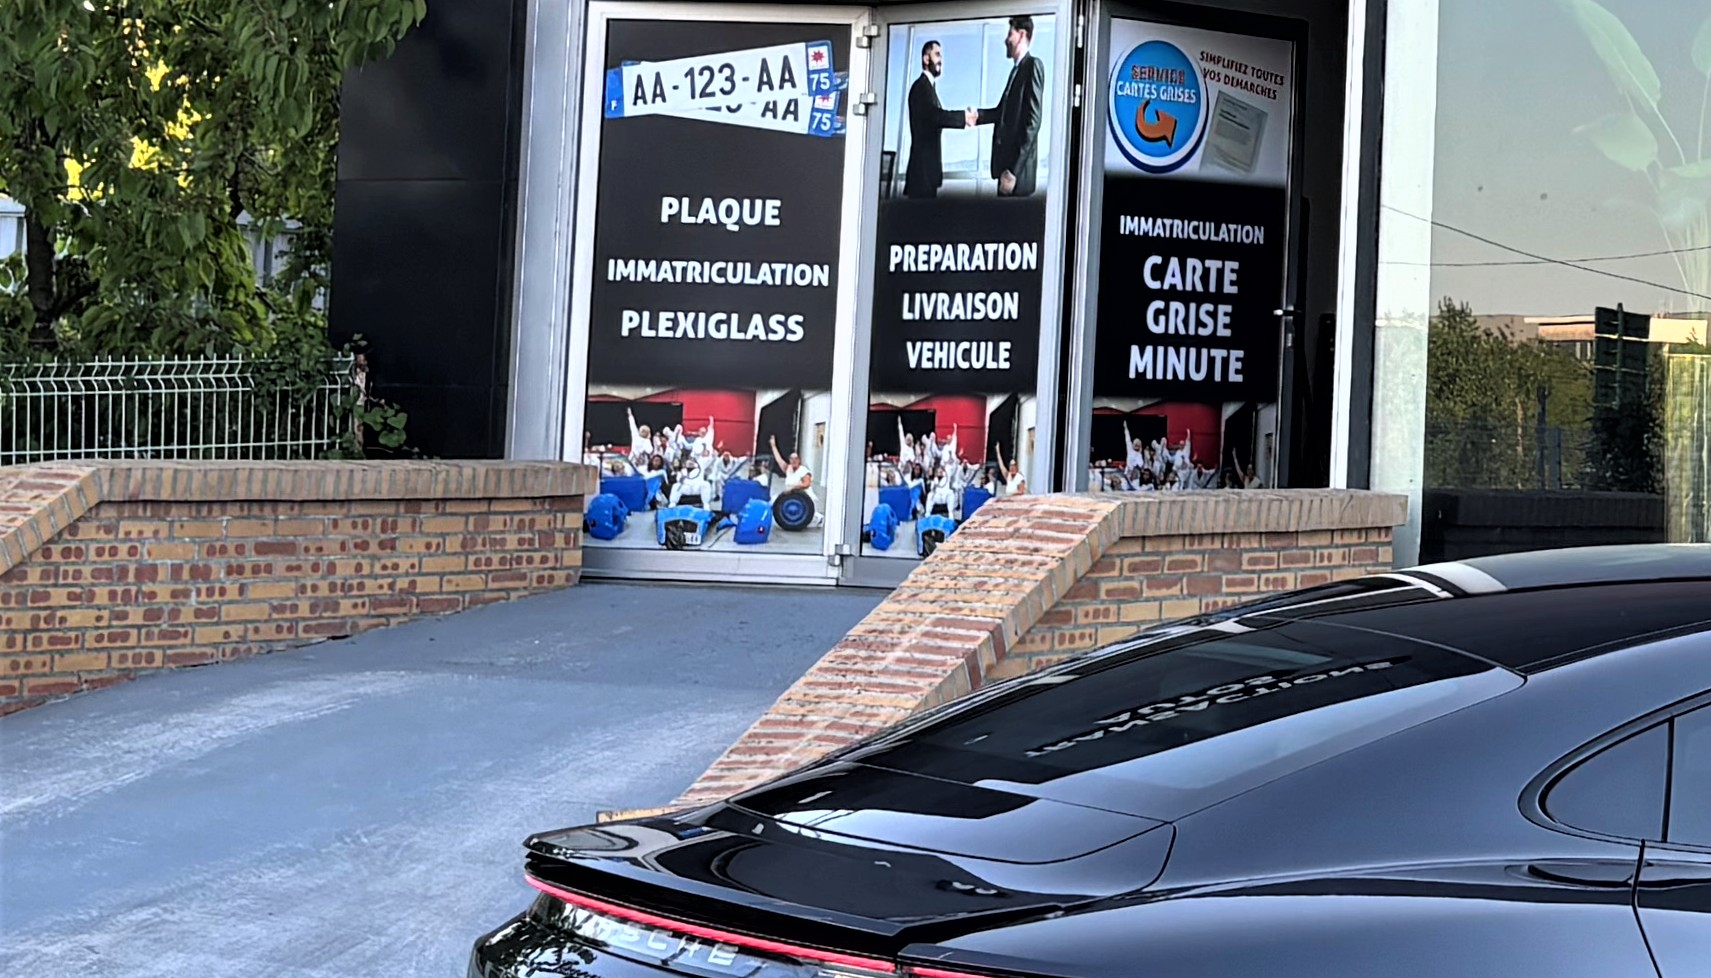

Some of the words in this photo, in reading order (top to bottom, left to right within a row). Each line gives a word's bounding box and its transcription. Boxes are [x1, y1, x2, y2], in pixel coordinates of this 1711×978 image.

[810, 72, 831, 91] 75
[1203, 67, 1222, 83] VOS
[1251, 66, 1285, 87] TOUTES
[1116, 81, 1158, 100] CARTES
[1160, 85, 1197, 104] GRISES
[811, 111, 832, 131] 75
[661, 196, 782, 232] PLAQUE
[1119, 214, 1265, 245] IMMATRICULATION
[889, 242, 1038, 272] PREPARATION
[607, 258, 830, 287] IMMATRICULATION
[1143, 254, 1240, 294] CARTE
[902, 291, 1019, 320] LIVRAISON
[1146, 299, 1233, 337] GRISE
[621, 309, 805, 342] PLEXIGLASS
[906, 340, 1012, 370] VEHICULE
[1128, 344, 1245, 383] MINUTE
